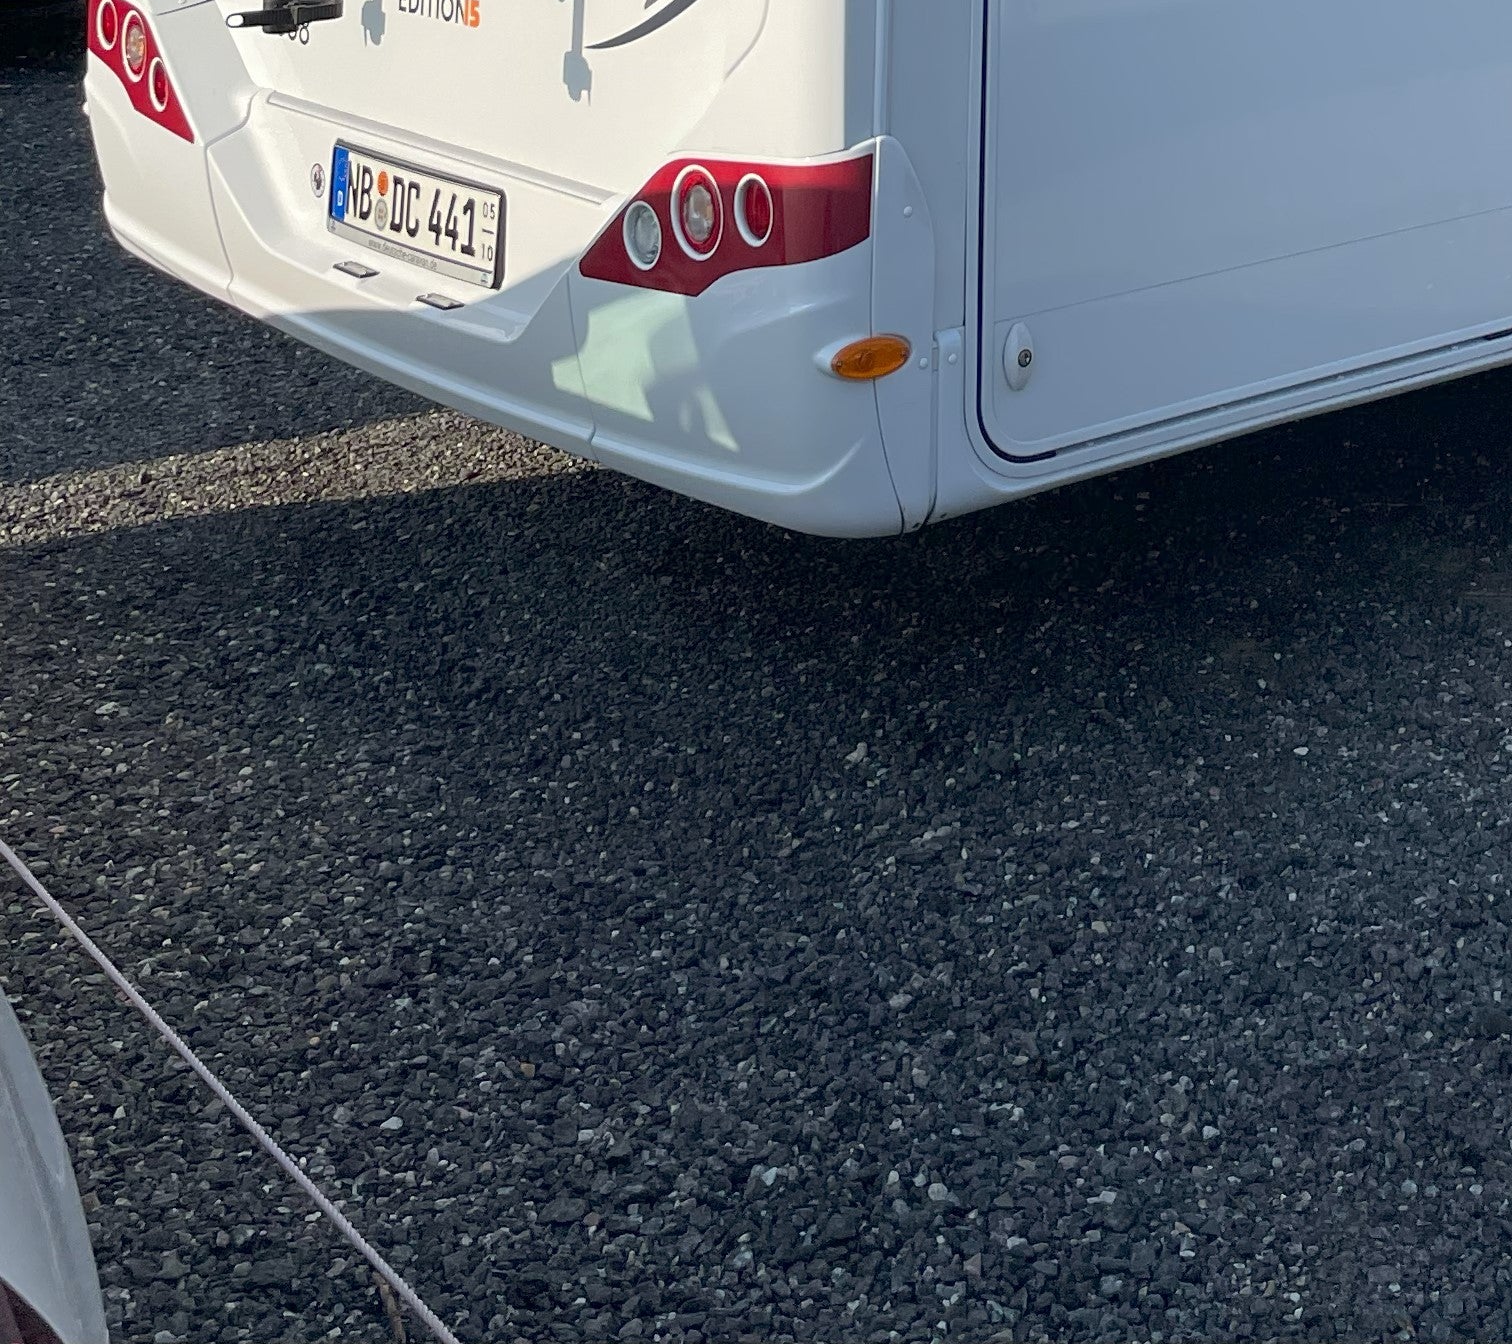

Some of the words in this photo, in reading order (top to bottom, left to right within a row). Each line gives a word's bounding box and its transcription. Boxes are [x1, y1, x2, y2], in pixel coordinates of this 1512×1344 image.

[346, 160, 374, 221] NB
[389, 174, 421, 238] DC
[428, 188, 477, 257] 441
[482, 201, 496, 220] 05
[481, 242, 494, 262] 10
